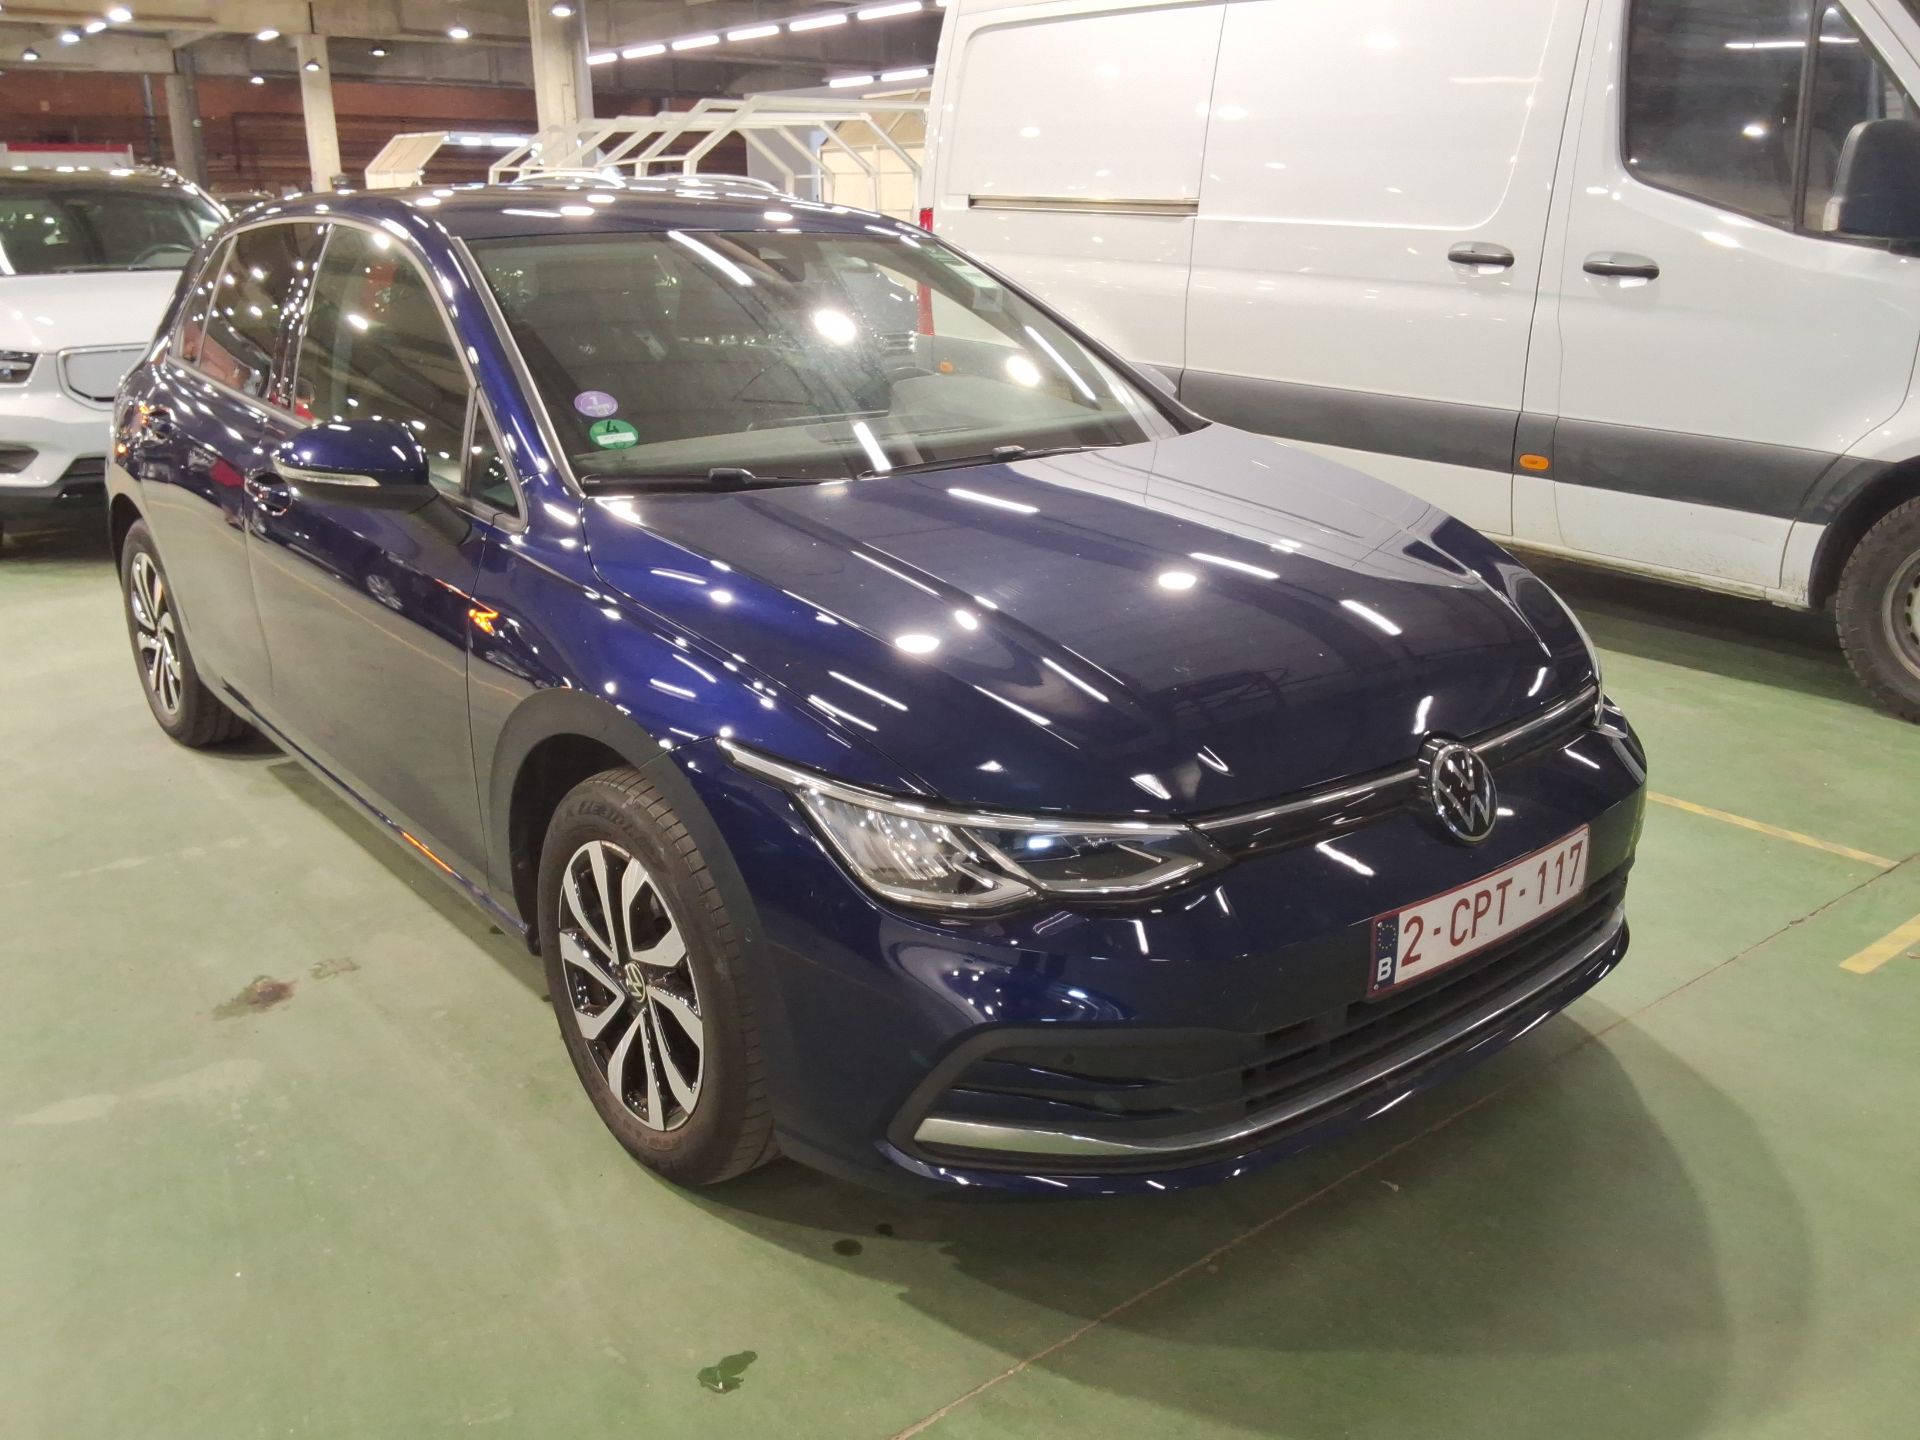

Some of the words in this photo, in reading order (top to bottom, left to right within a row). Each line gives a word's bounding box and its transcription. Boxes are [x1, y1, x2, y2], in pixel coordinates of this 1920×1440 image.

[606, 421, 619, 433] 4
[1401, 840, 1584, 968] 2-CPT-117
[1377, 957, 1392, 982] B
